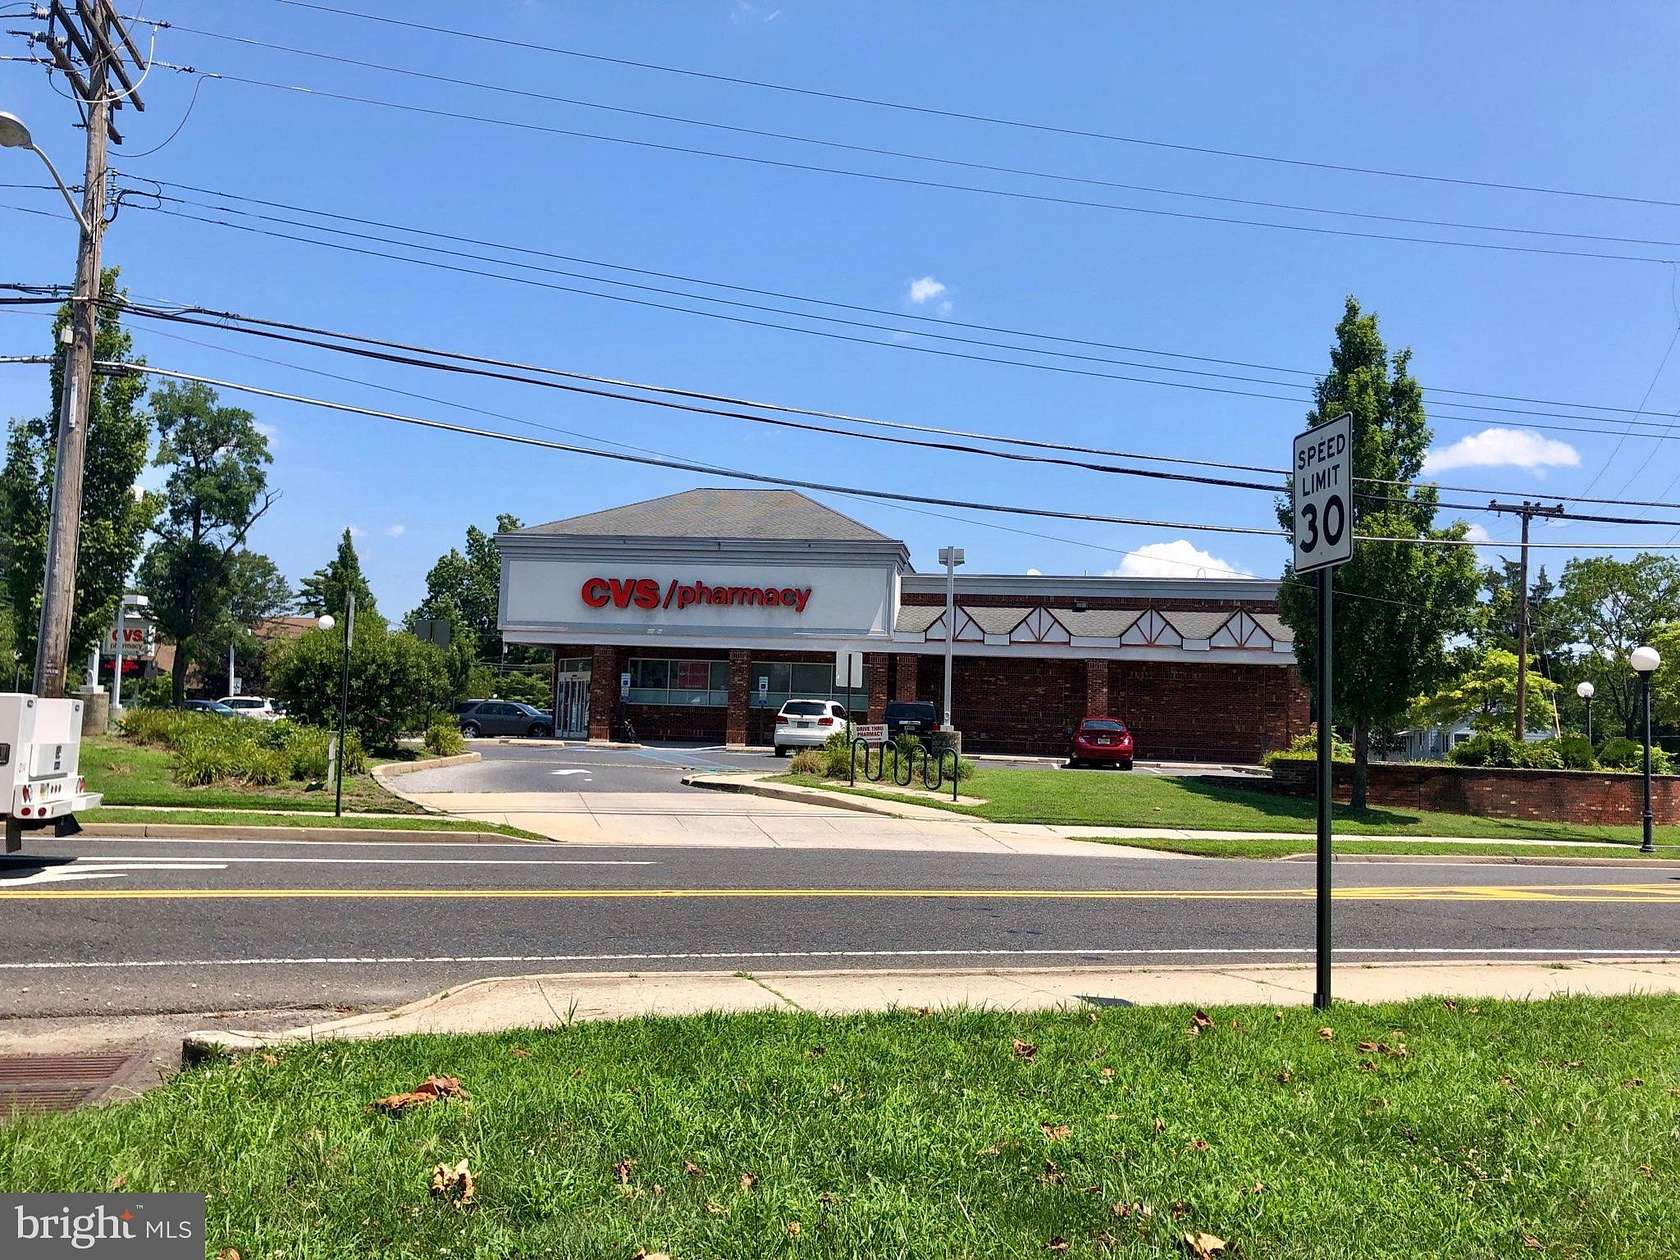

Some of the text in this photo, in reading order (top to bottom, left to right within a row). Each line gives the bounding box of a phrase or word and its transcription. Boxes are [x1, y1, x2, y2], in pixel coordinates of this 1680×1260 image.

[1298, 433, 1346, 470] SPEED
[1302, 464, 1341, 497] LIMIT
[1299, 494, 1345, 553] 30
